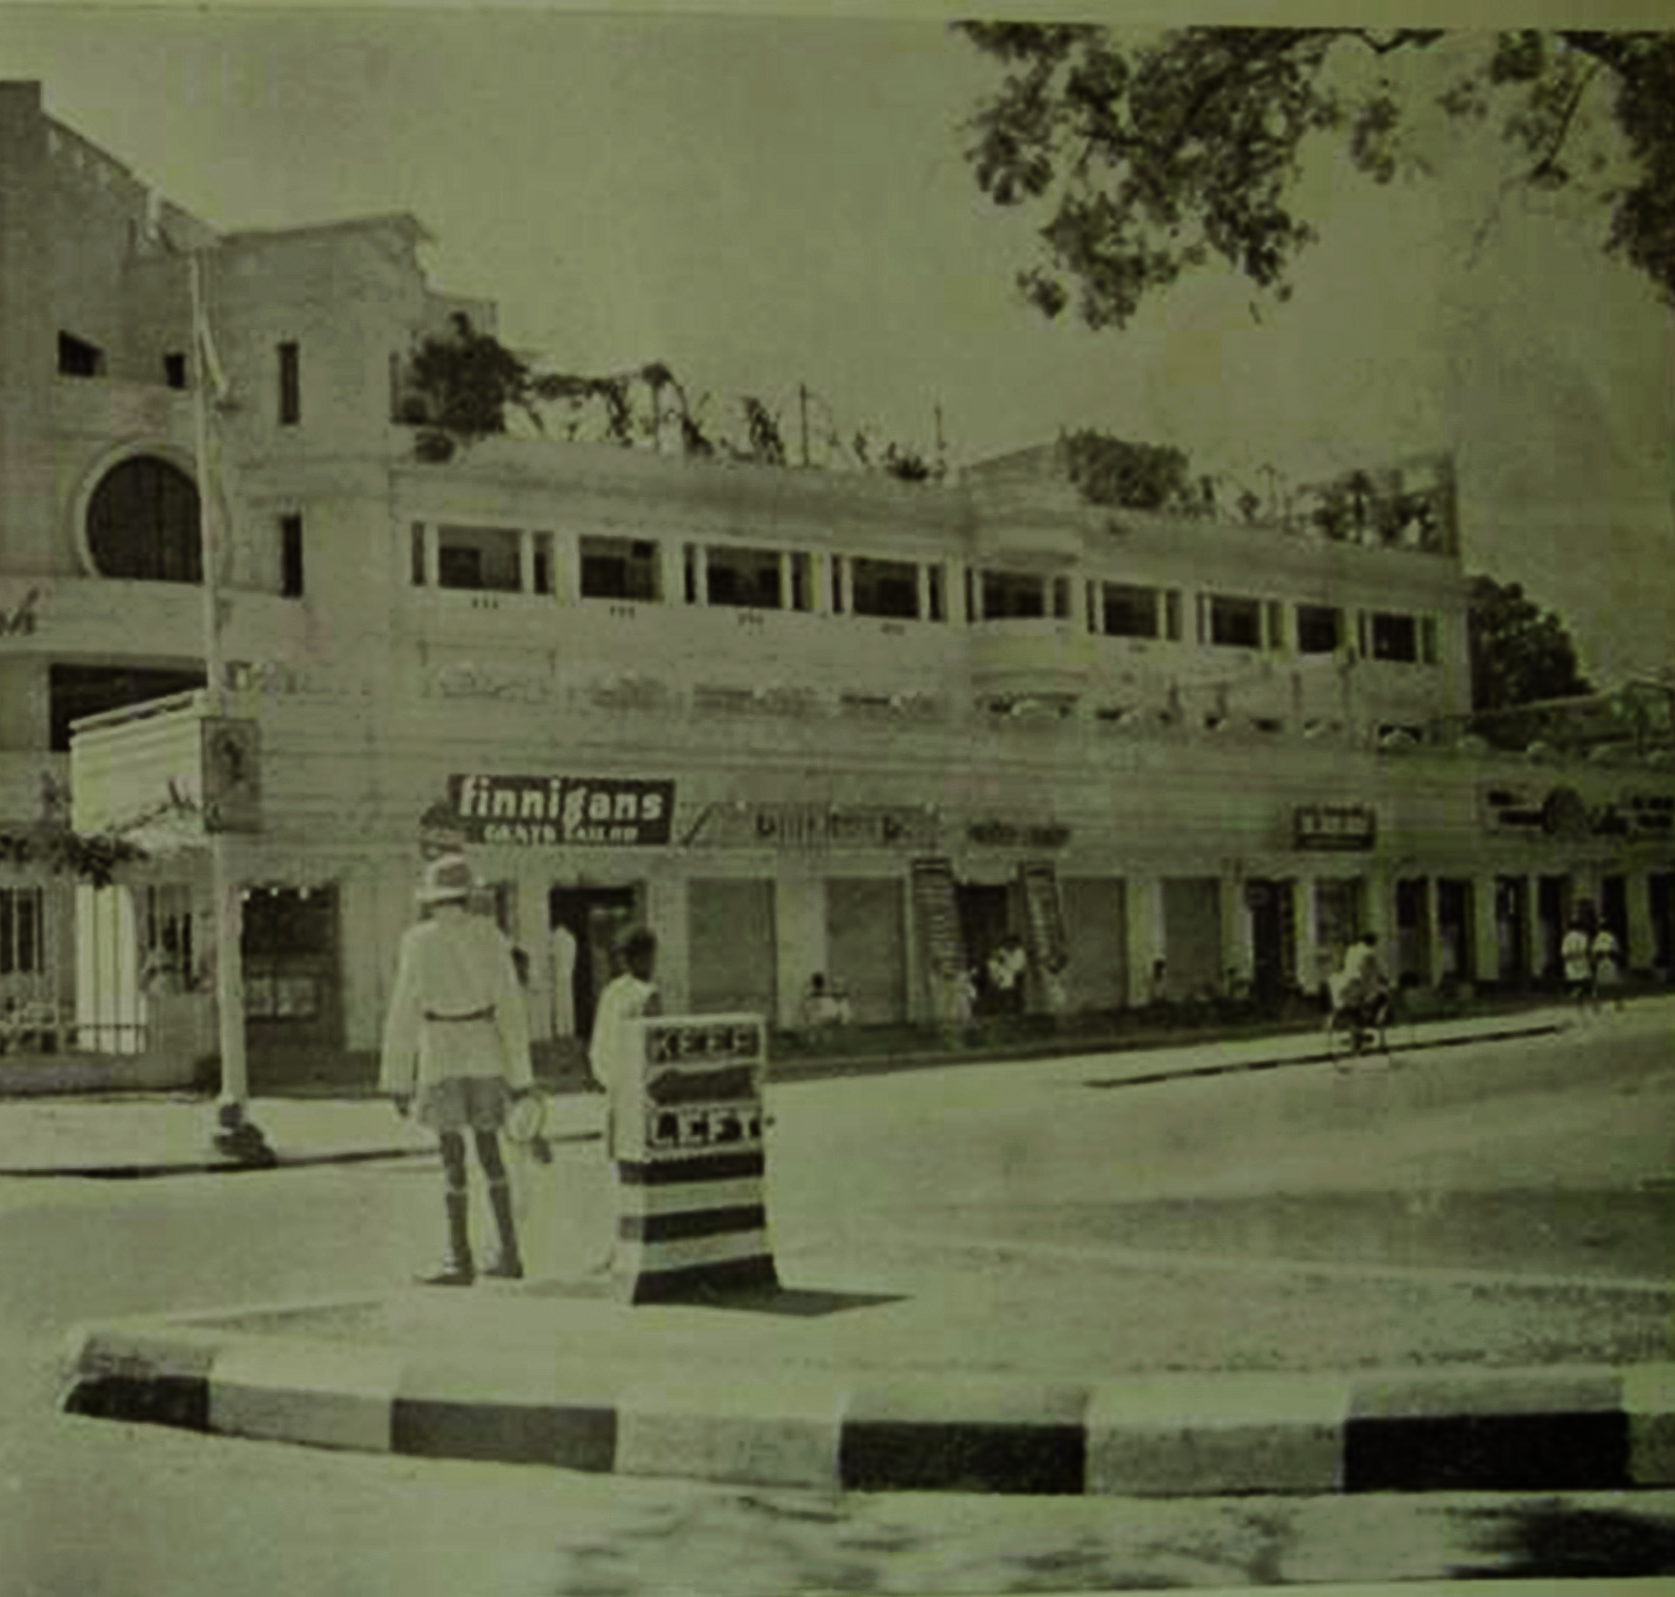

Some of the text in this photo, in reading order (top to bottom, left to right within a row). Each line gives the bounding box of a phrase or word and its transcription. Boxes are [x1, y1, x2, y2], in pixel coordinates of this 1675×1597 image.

[458, 776, 664, 830] finnigans
[648, 1022, 751, 1064] KEEP
[647, 1106, 762, 1149] LEFT
